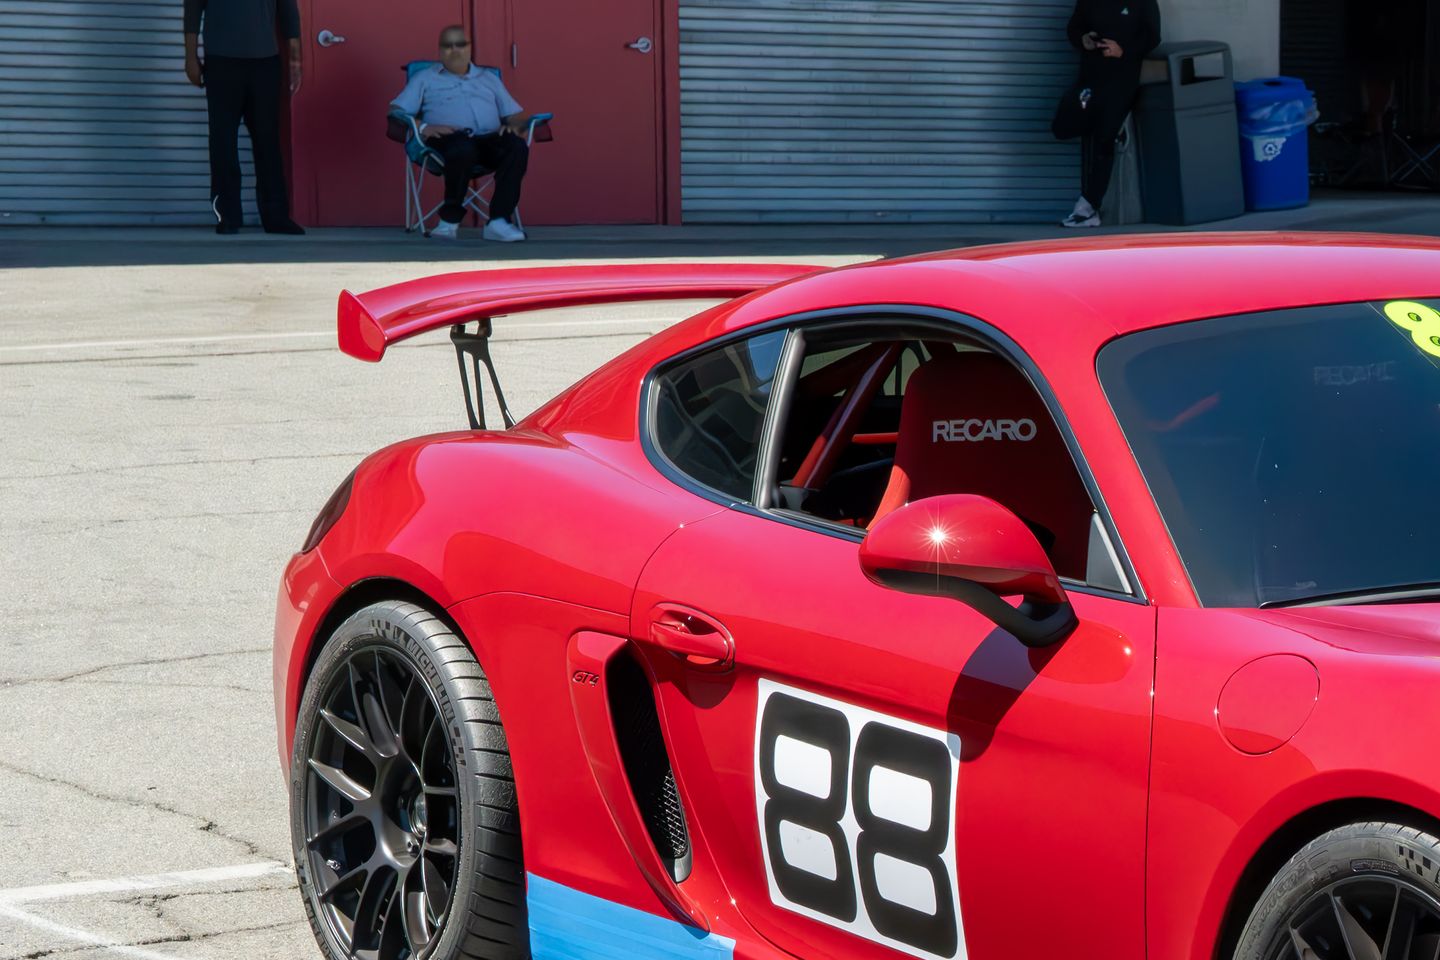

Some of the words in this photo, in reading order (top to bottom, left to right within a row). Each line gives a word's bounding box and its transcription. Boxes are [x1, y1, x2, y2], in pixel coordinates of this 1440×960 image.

[933, 419, 1037, 442] RECARO
[406, 638, 455, 723] MICHELIN
[573, 671, 600, 687] GT4
[760, 691, 958, 959] 88
